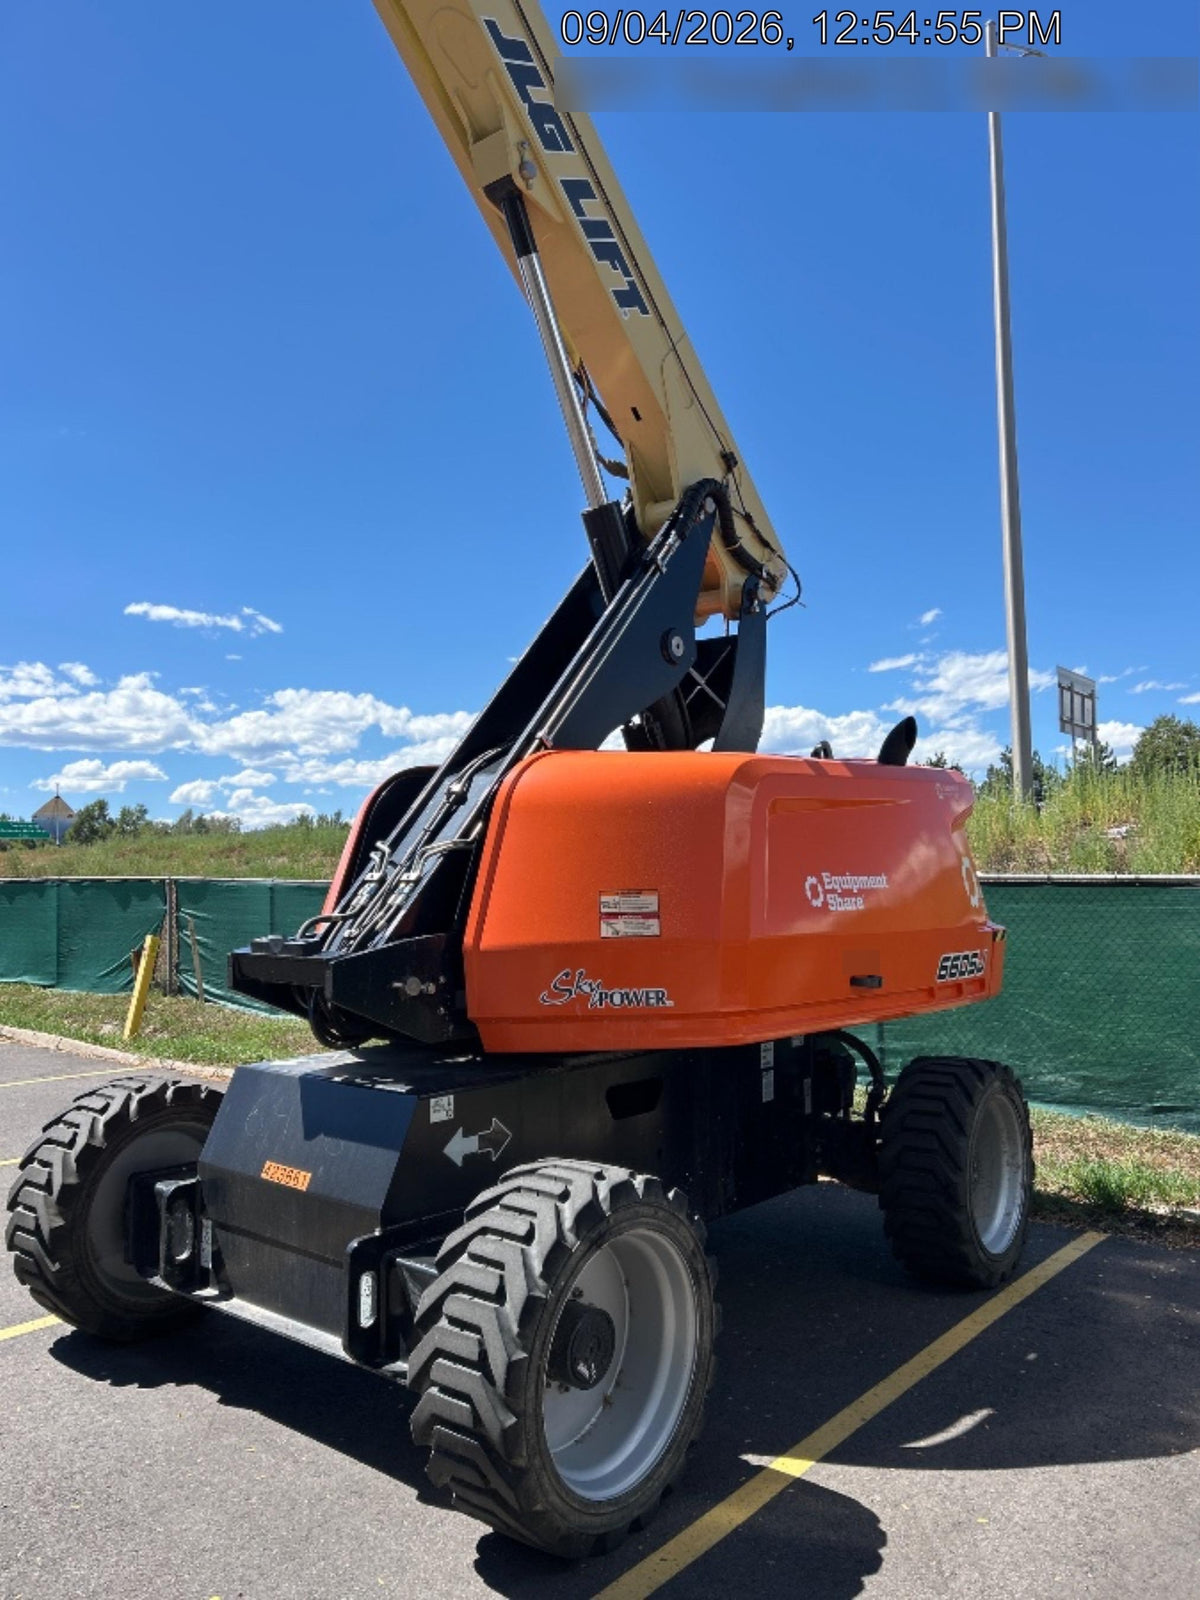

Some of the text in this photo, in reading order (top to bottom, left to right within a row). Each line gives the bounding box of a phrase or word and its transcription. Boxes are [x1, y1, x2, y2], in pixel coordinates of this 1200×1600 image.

[481, 16, 649, 316] JLG LIFT
[821, 872, 888, 894] Equipment
[826, 893, 865, 912] Share
